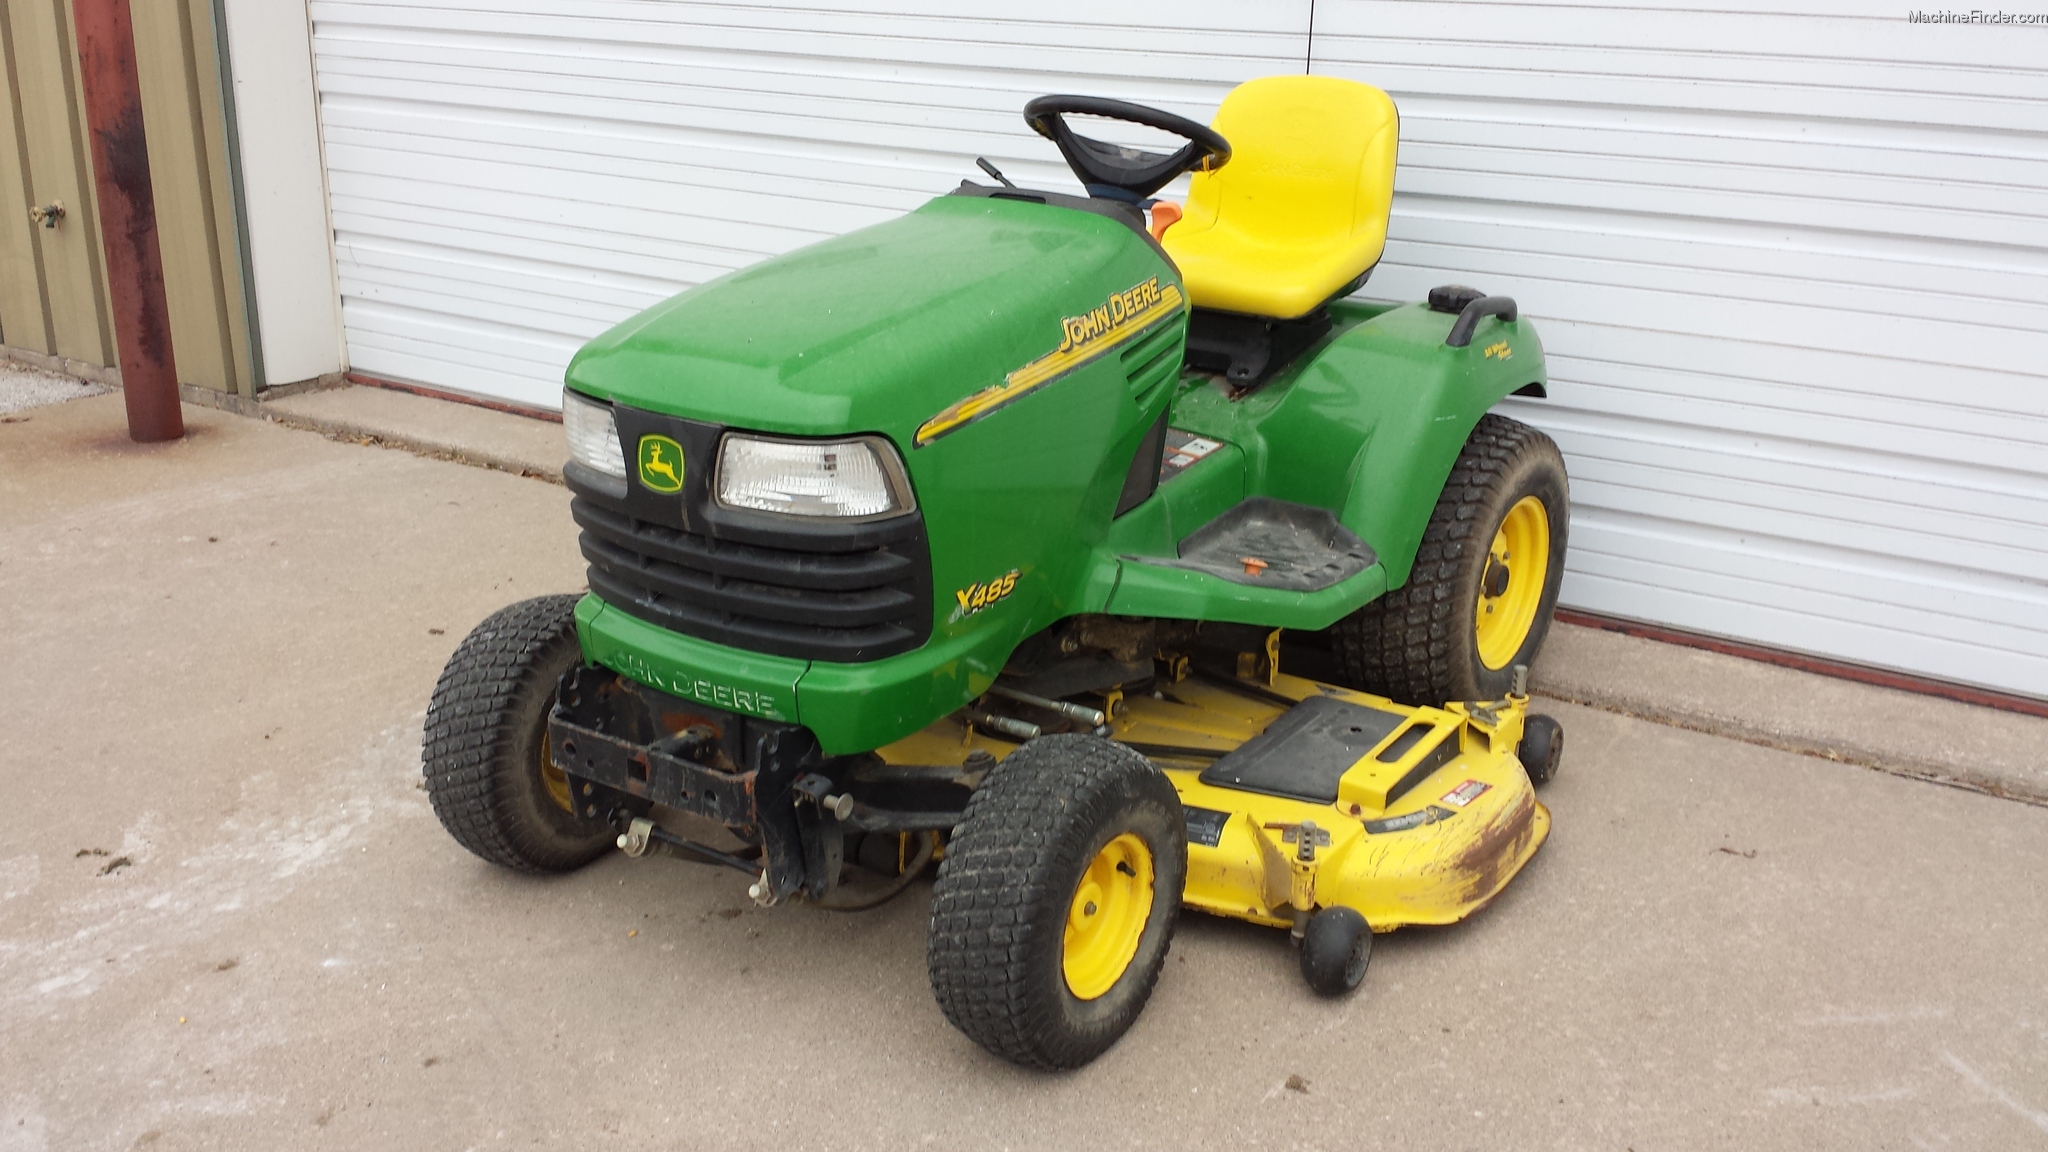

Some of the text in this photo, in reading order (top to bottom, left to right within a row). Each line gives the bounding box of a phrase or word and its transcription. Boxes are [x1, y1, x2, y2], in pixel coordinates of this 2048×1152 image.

[1059, 274, 1161, 353] JOHN DEERE
[673, 671, 782, 718] DEERE
